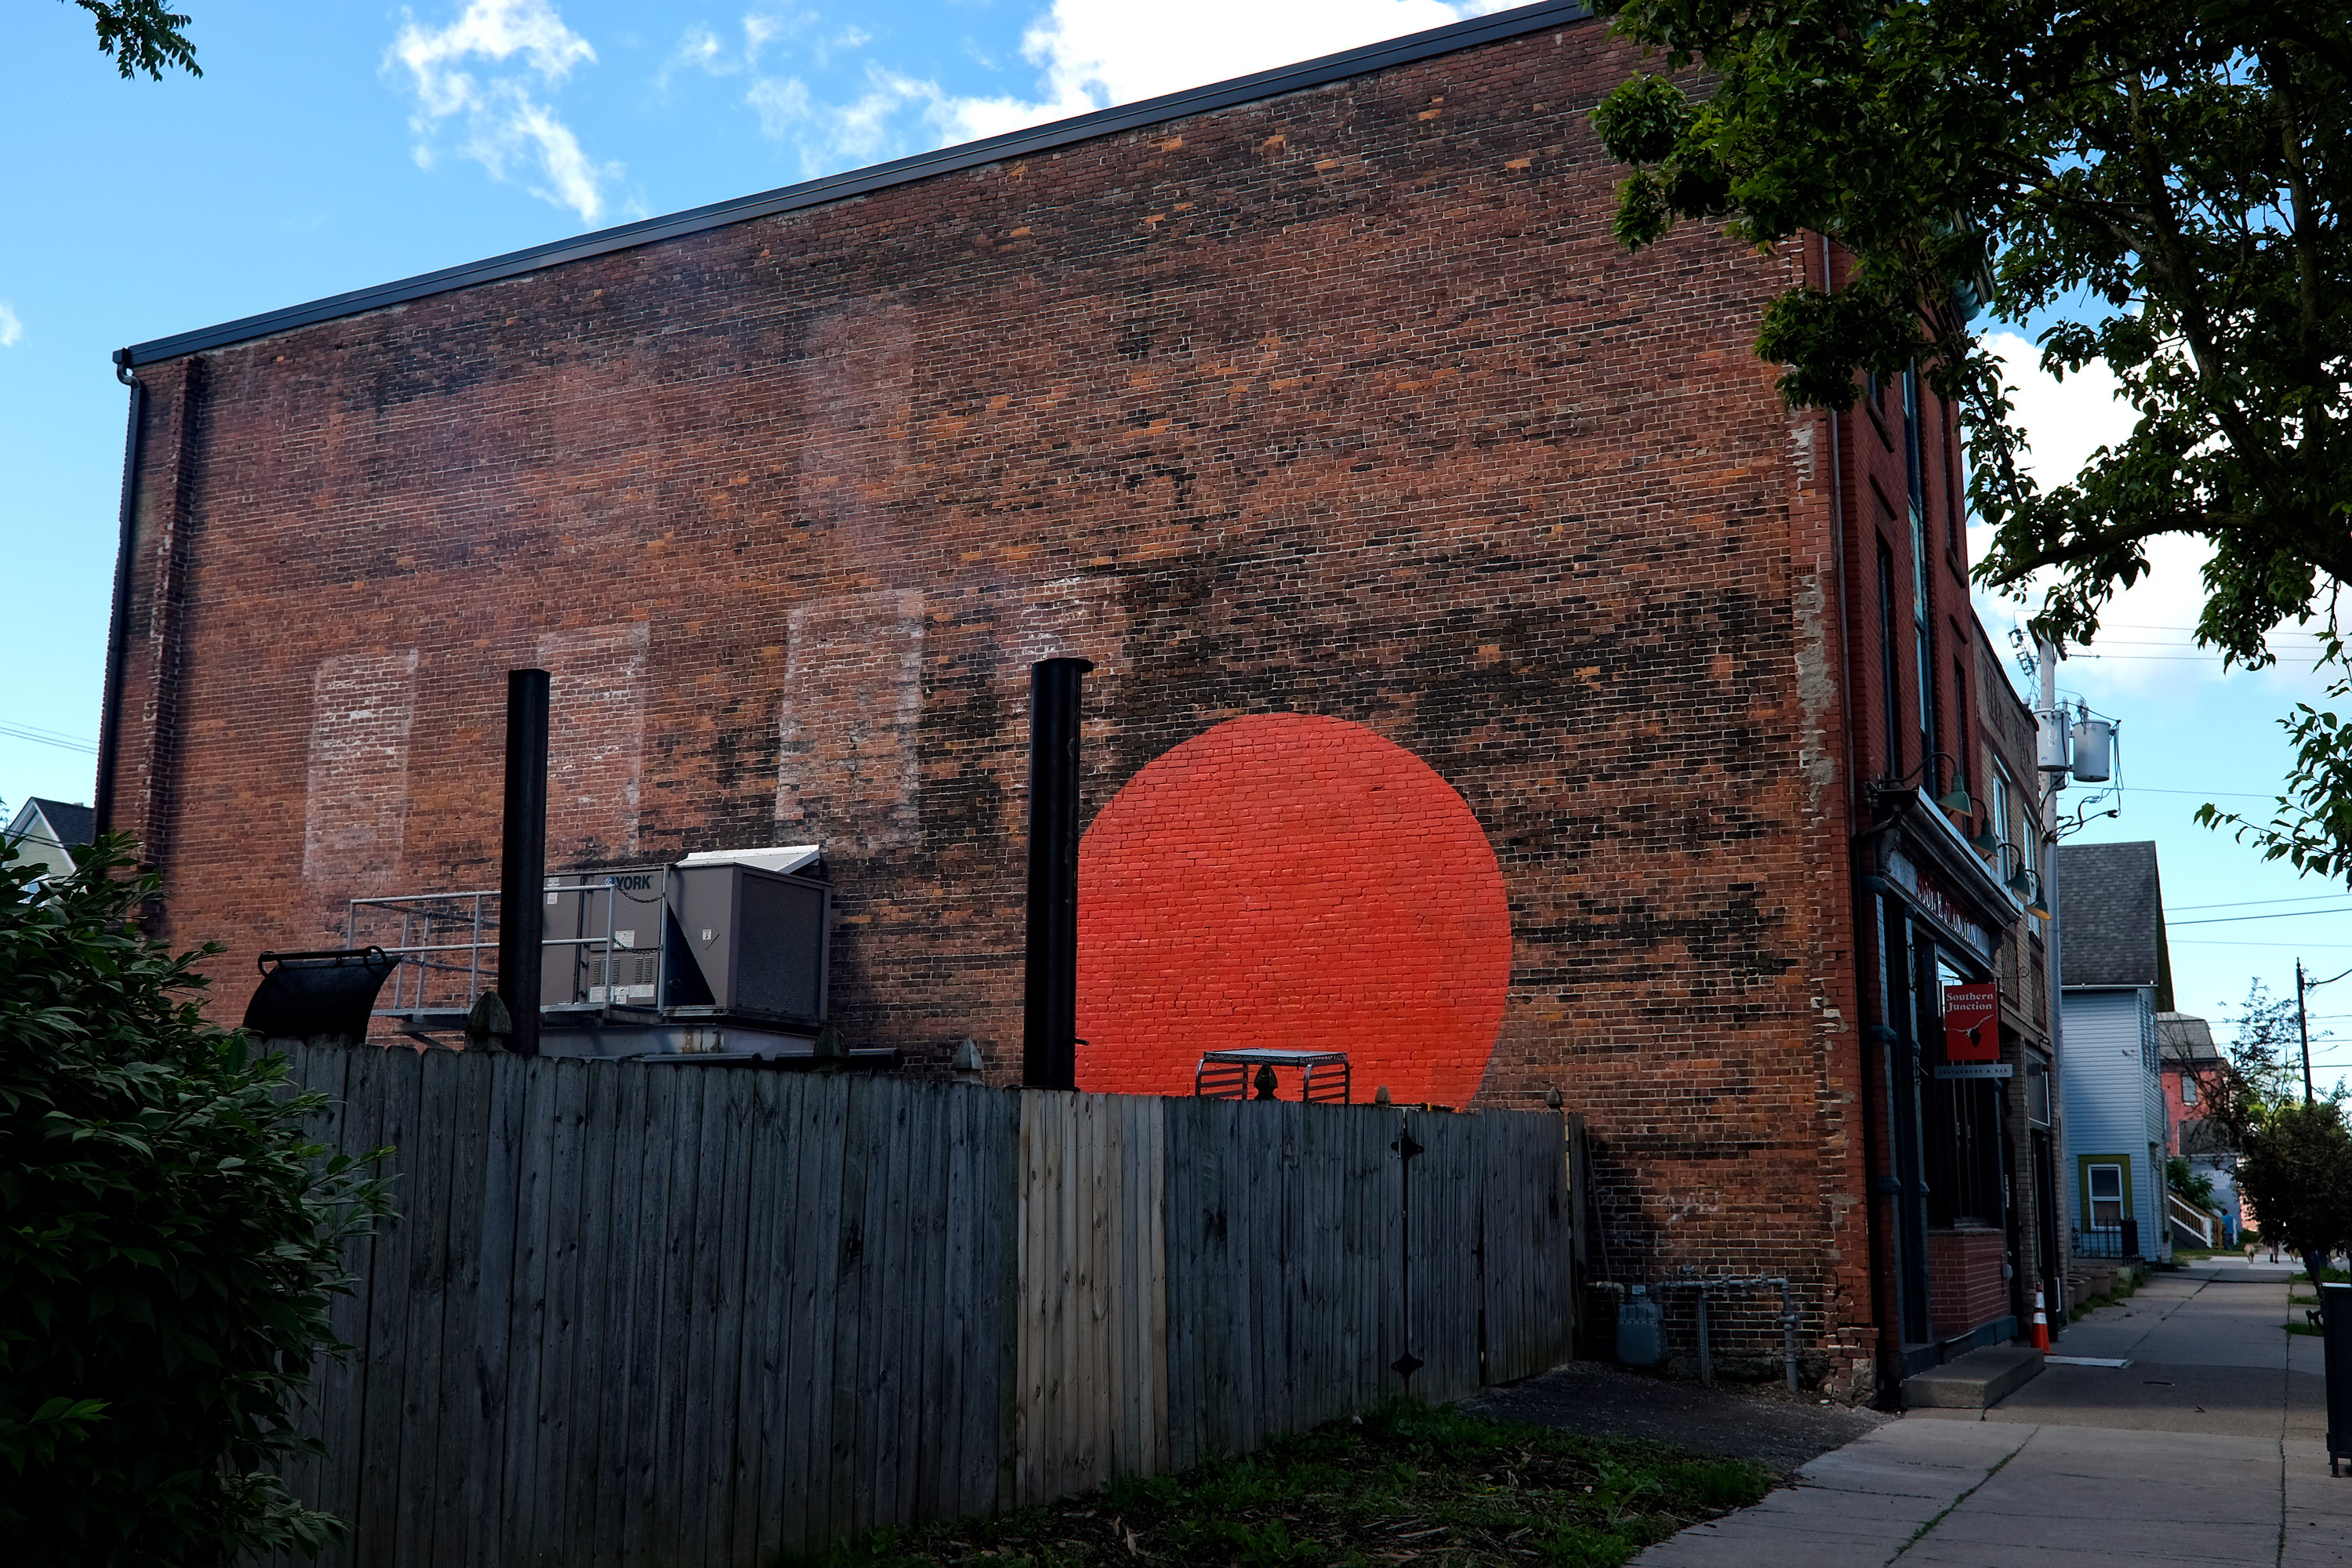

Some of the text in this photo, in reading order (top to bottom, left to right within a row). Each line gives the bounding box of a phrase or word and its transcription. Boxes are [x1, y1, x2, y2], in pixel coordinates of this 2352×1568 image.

[616, 875, 650, 890] YORK
[1947, 993, 1993, 1001] Southern
[1947, 1002, 1992, 1012] Junction
